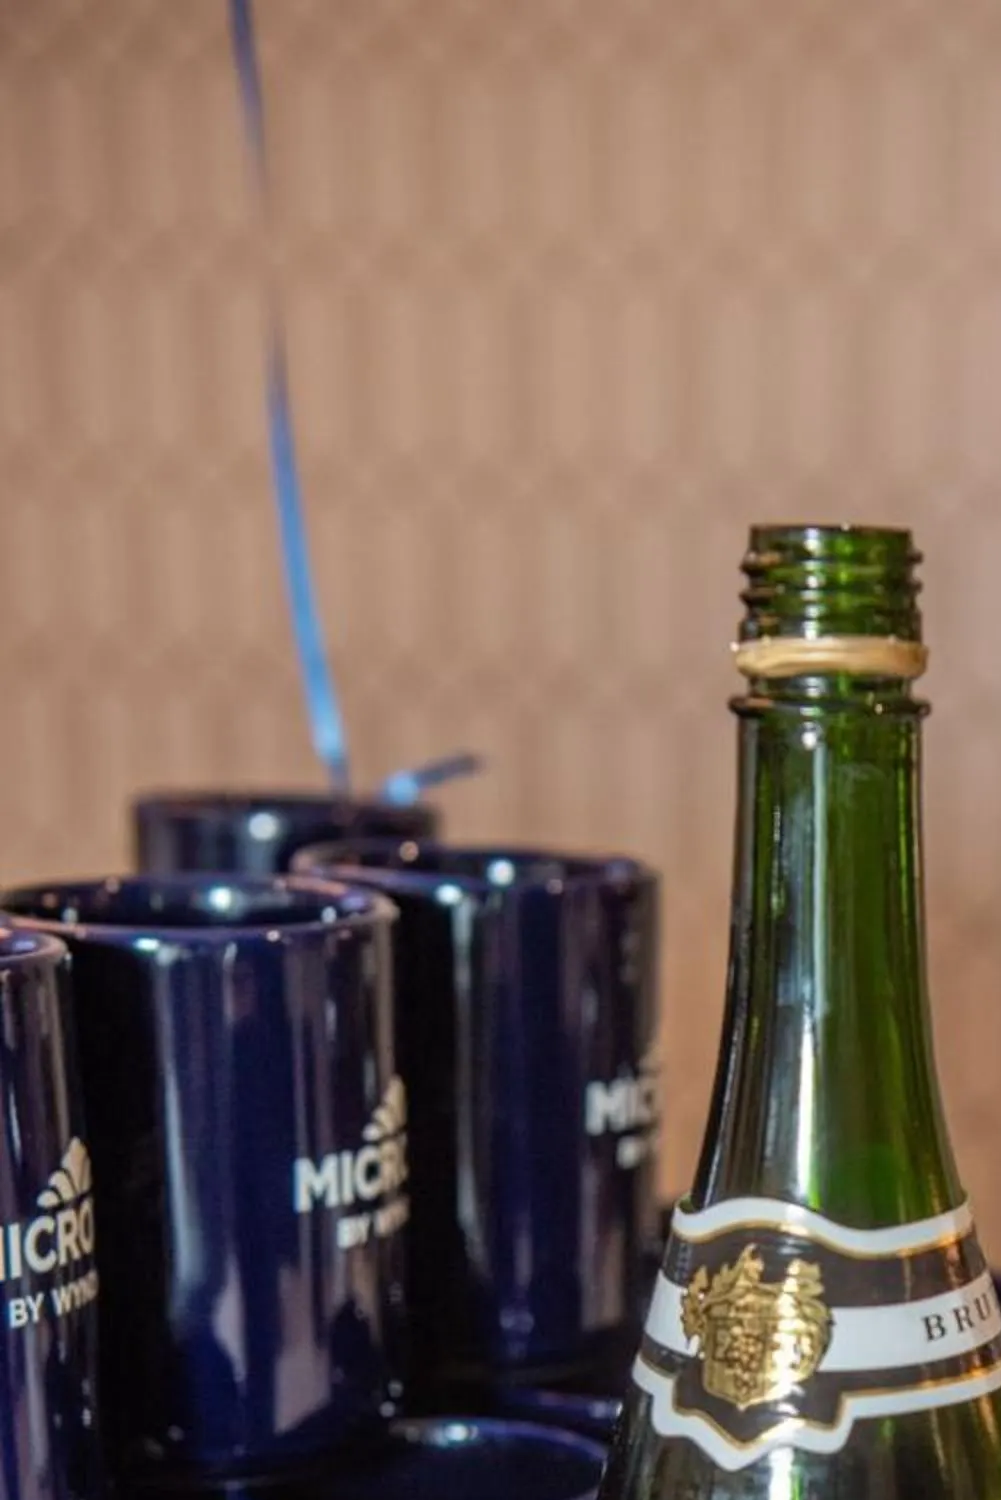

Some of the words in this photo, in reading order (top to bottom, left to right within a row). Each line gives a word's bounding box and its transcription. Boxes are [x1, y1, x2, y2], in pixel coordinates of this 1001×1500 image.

[0, 1198, 94, 1281] ICRO
[9, 1293, 45, 1328] BY
[922, 1285, 995, 1341] BRU
